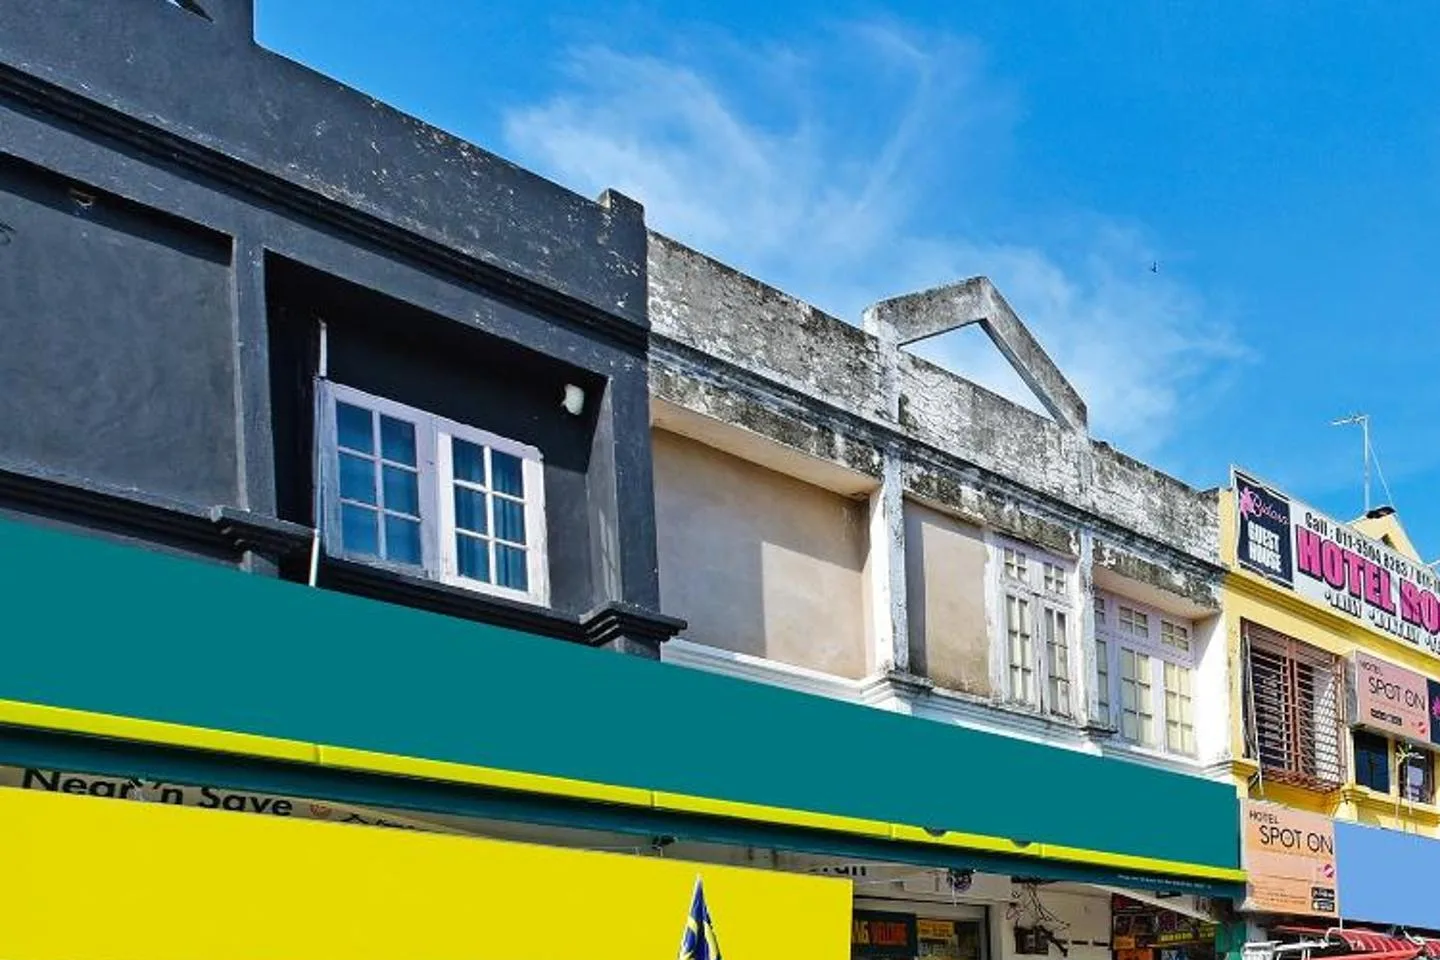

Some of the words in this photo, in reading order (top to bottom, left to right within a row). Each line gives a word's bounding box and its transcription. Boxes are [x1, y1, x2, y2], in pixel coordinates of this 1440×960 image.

[1295, 523, 1396, 617] HOTEL
[1368, 676, 1401, 702] SPOT
[1404, 690, 1425, 711] ON
[199, 785, 293, 817] Save
[1249, 809, 1280, 825] HOTEL
[1259, 825, 1302, 849] SPOT
[1307, 832, 1334, 855] ON
